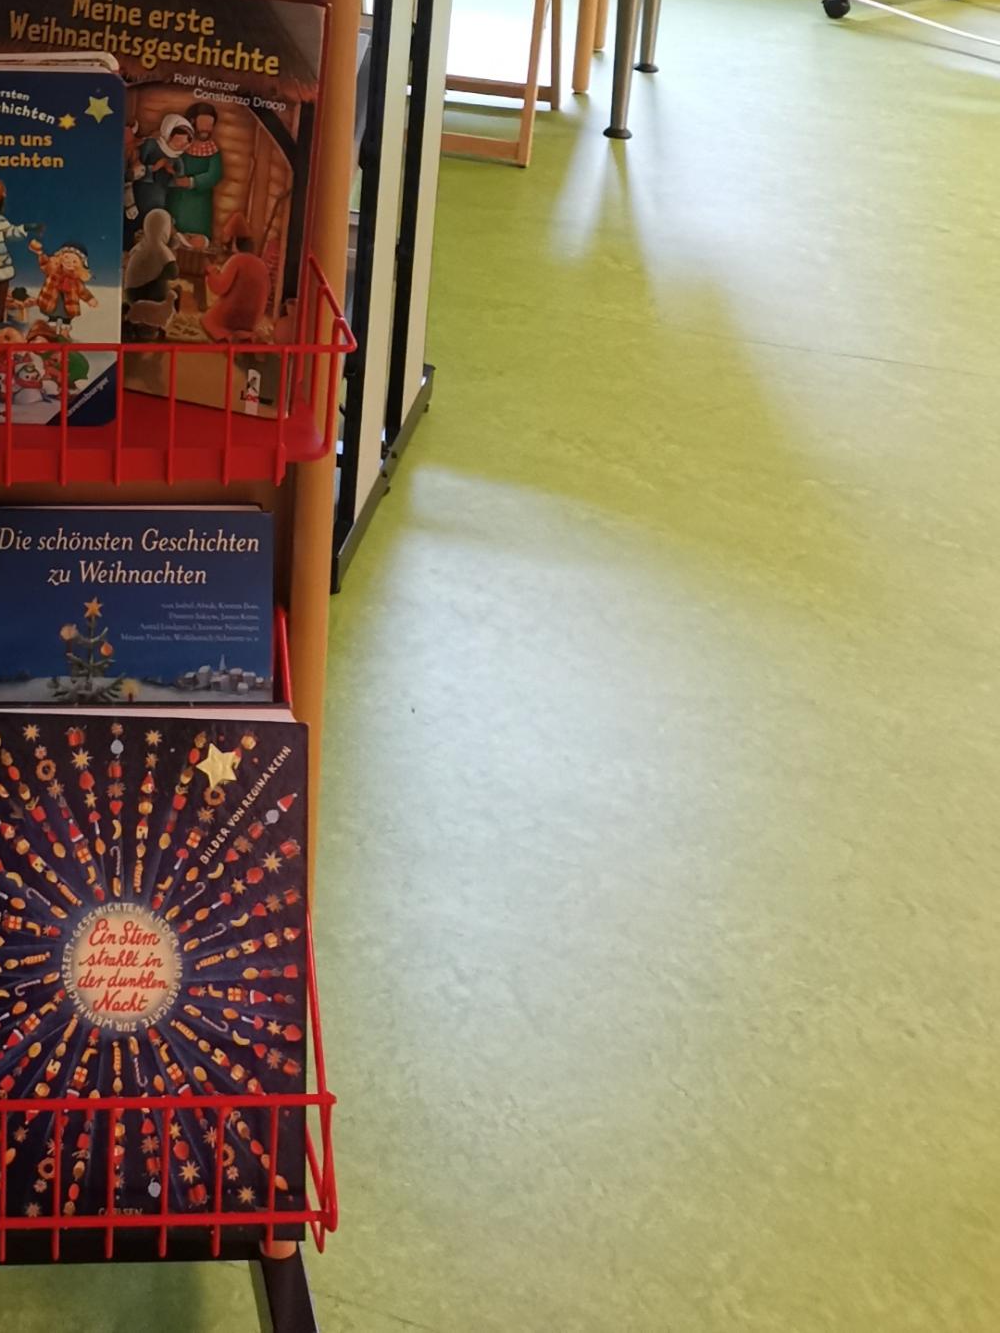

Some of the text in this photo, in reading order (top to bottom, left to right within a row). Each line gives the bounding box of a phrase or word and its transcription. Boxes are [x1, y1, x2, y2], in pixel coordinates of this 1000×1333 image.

[148, 5, 216, 35] erste
[9, 9, 281, 76] Weihnachtsgeschichte
[173, 72, 240, 92] Rolf Krenzer
[19, 133, 53, 147] uns
[37, 527, 134, 552] schönsten
[141, 528, 260, 553] Geschichten
[46, 561, 208, 586] zu Weihnachten
[227, 807, 246, 827] VON
[241, 772, 271, 809] REGINA
[88, 917, 117, 947] Ein
[78, 947, 164, 968] strahlt in
[77, 968, 169, 990] der dunklen
[92, 989, 149, 1012] Nacht
